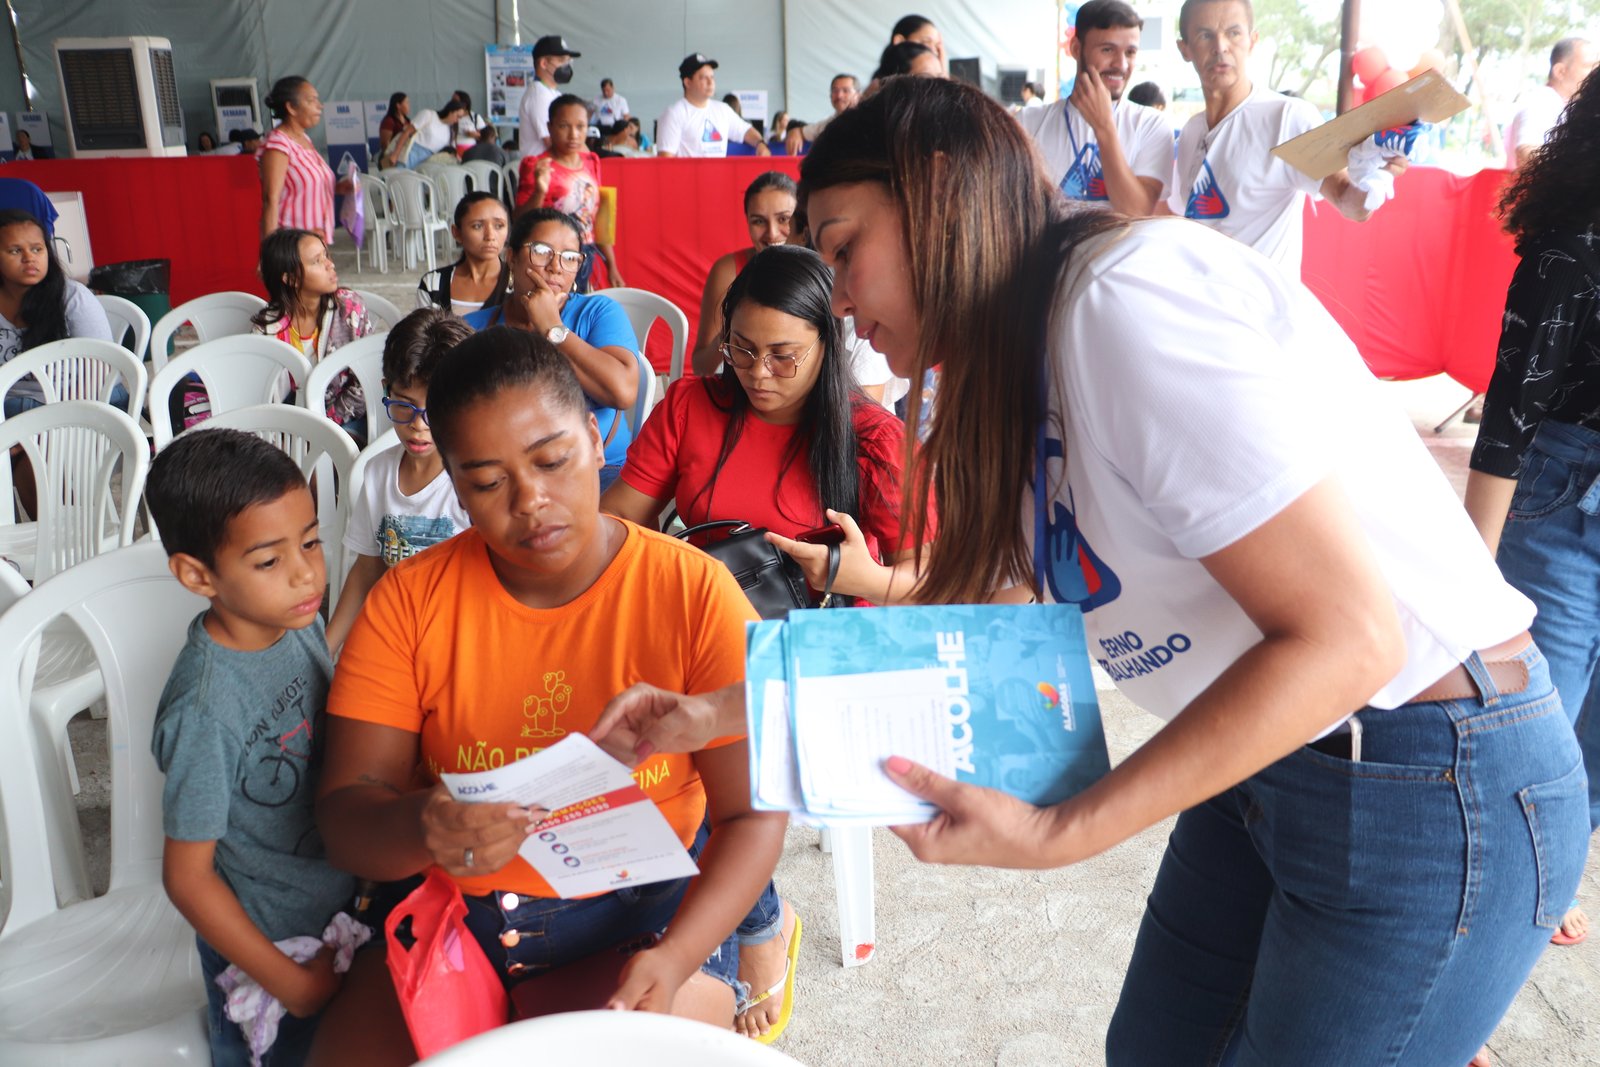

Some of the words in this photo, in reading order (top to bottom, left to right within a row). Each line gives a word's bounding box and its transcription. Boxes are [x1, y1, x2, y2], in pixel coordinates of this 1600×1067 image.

[336, 104, 350, 113] IMA
[935, 630, 976, 774] ACOLHE
[456, 741, 505, 772] NÃO
